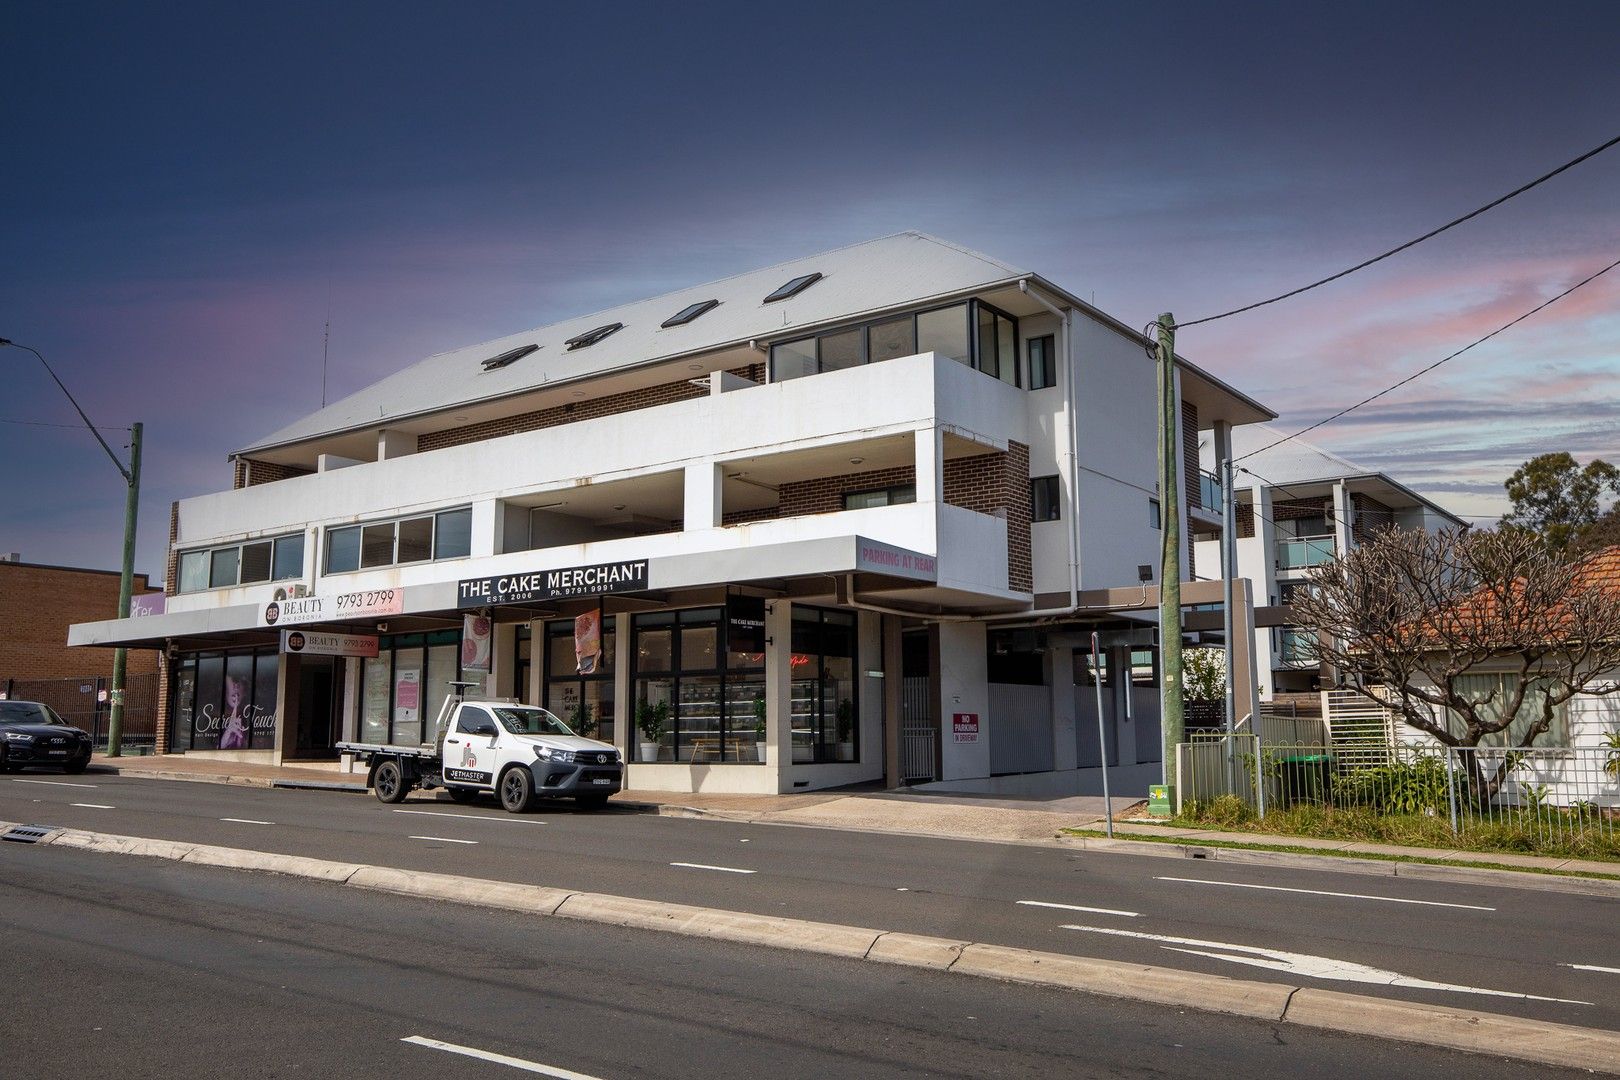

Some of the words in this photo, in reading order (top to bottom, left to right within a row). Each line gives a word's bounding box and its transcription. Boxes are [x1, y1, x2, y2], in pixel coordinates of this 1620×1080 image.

[863, 547, 899, 567] PARKING
[902, 554, 912, 569] AT
[914, 556, 935, 573] REAR
[460, 580, 491, 598] THE
[497, 574, 541, 594] CAKE
[547, 563, 646, 589] MERCHANT
[550, 589, 562, 597] Ph.
[565, 587, 588, 595] 9791
[591, 584, 614, 593] 9991
[336, 593, 363, 609] 9793
[366, 590, 395, 607] 2799
[486, 595, 505, 603] EST.
[510, 592, 532, 601] 2006
[283, 598, 324, 615] BEAUTY
[309, 636, 339, 646] BEAUTY
[961, 714, 970, 723] NO
[954, 723, 978, 732] PARKING
[450, 770, 485, 780] JETMASTER
